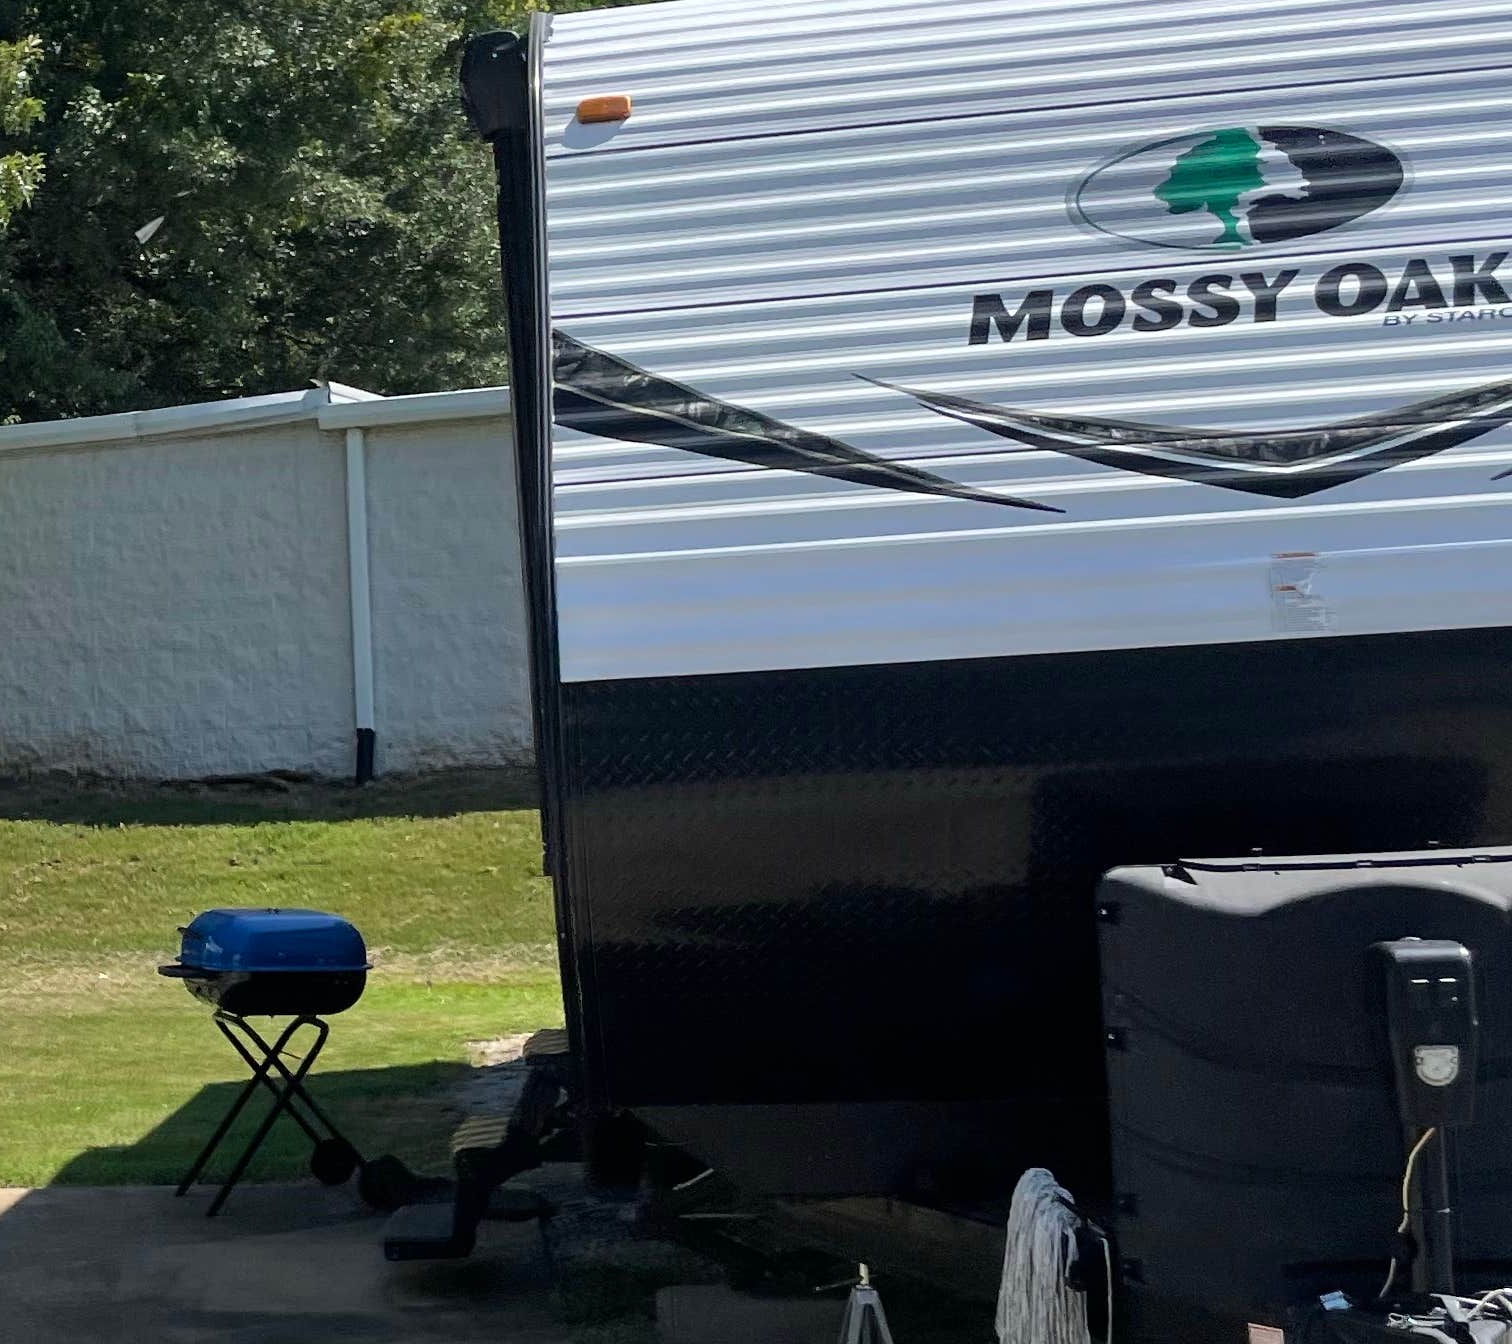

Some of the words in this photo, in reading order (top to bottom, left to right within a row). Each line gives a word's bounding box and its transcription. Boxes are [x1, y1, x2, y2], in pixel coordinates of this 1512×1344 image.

[968, 268, 1300, 346] MOSSY
[1314, 251, 1512, 317] OAK
[1382, 313, 1417, 327] BY
